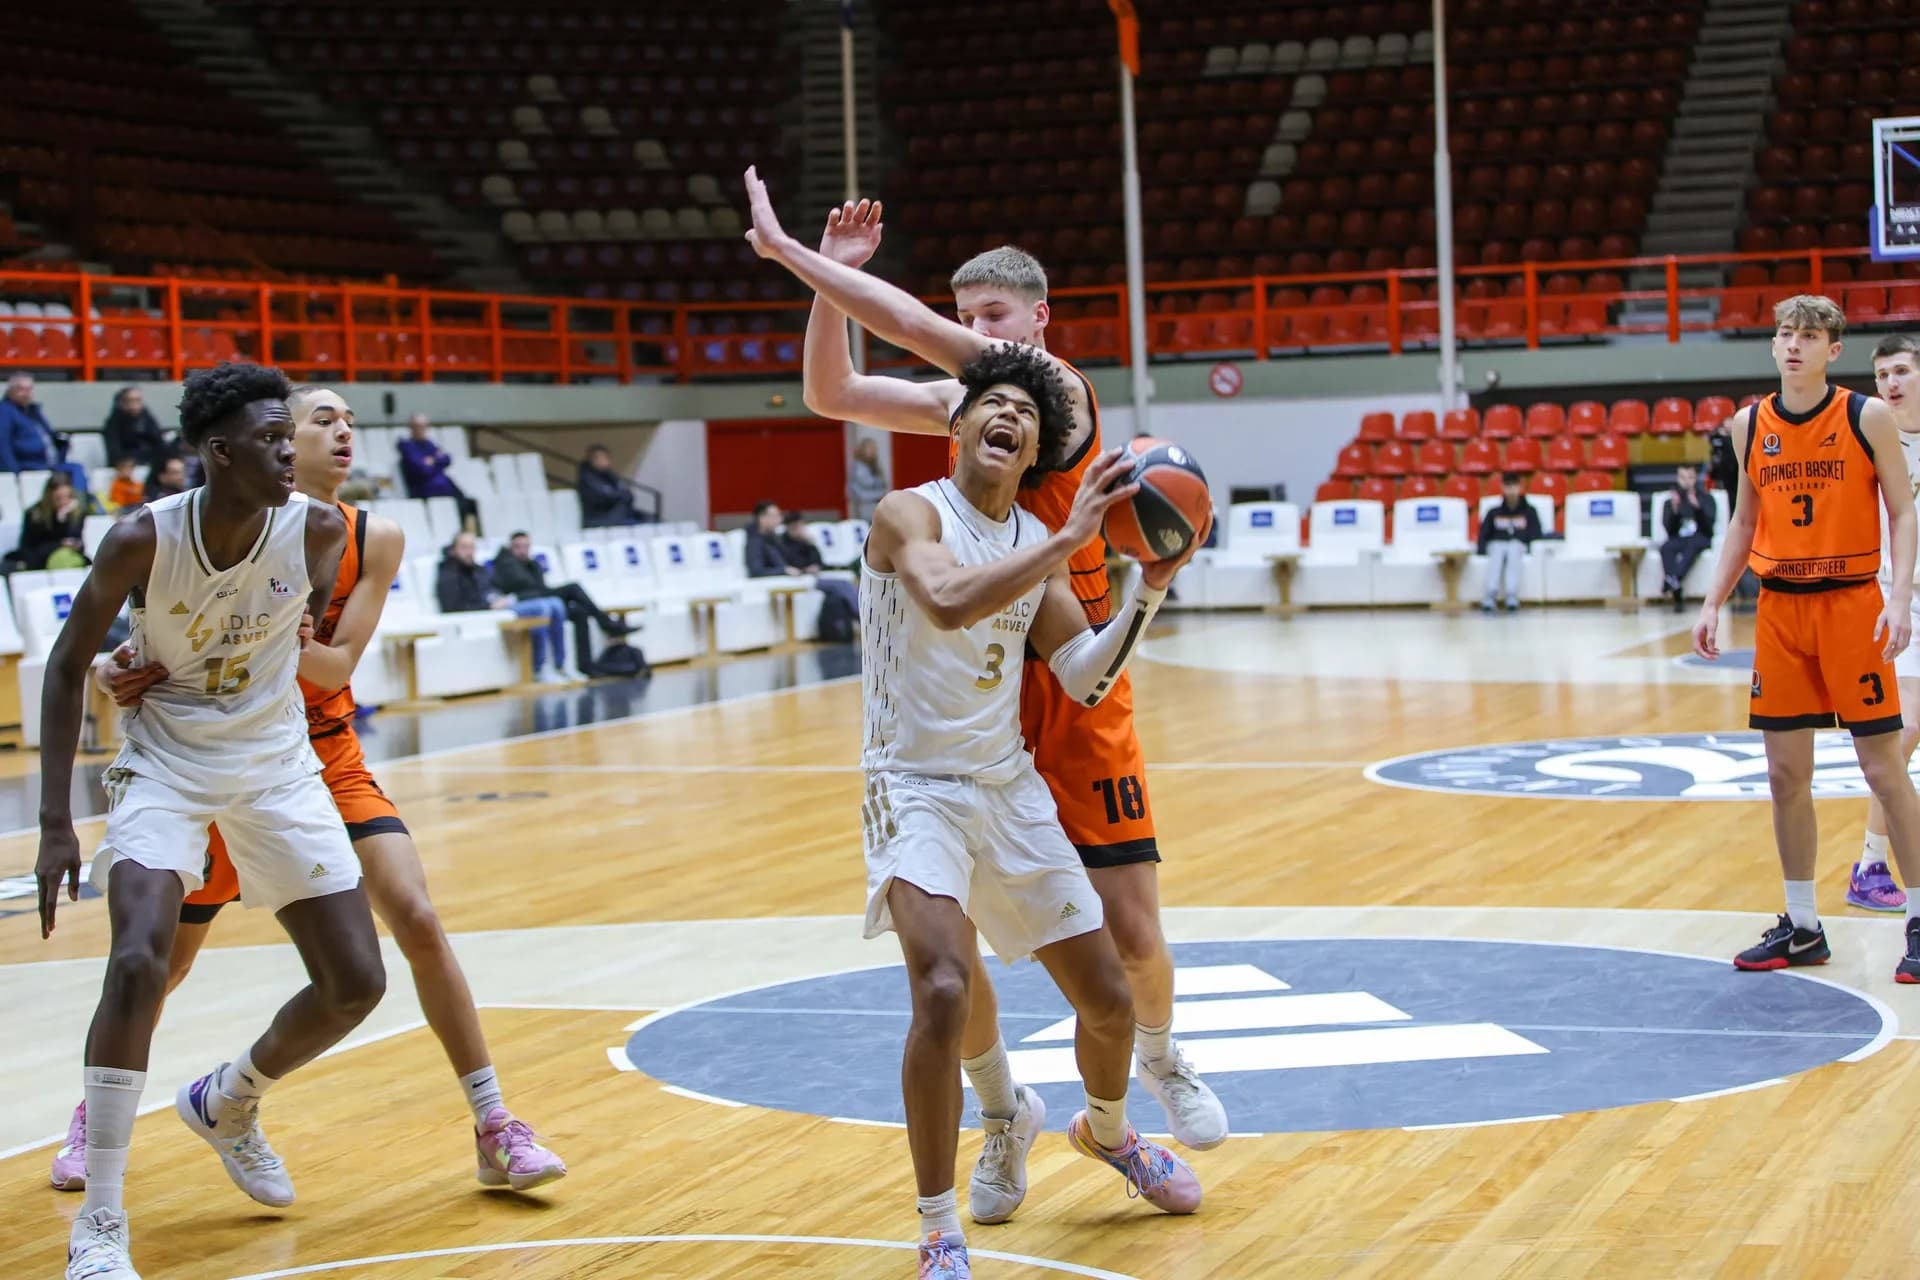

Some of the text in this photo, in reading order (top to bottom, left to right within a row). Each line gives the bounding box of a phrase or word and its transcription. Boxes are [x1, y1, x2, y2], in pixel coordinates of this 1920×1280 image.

[1805, 460, 1845, 481] BASKET
[1791, 494, 1813, 527] 3
[220, 613, 271, 631] LDLC
[991, 618, 1027, 633] ASVEL
[1002, 601, 1031, 618] DLC
[204, 652, 250, 696] 15
[975, 643, 1005, 690] 3
[1859, 672, 1885, 706] 3
[1092, 776, 1145, 824] 18
